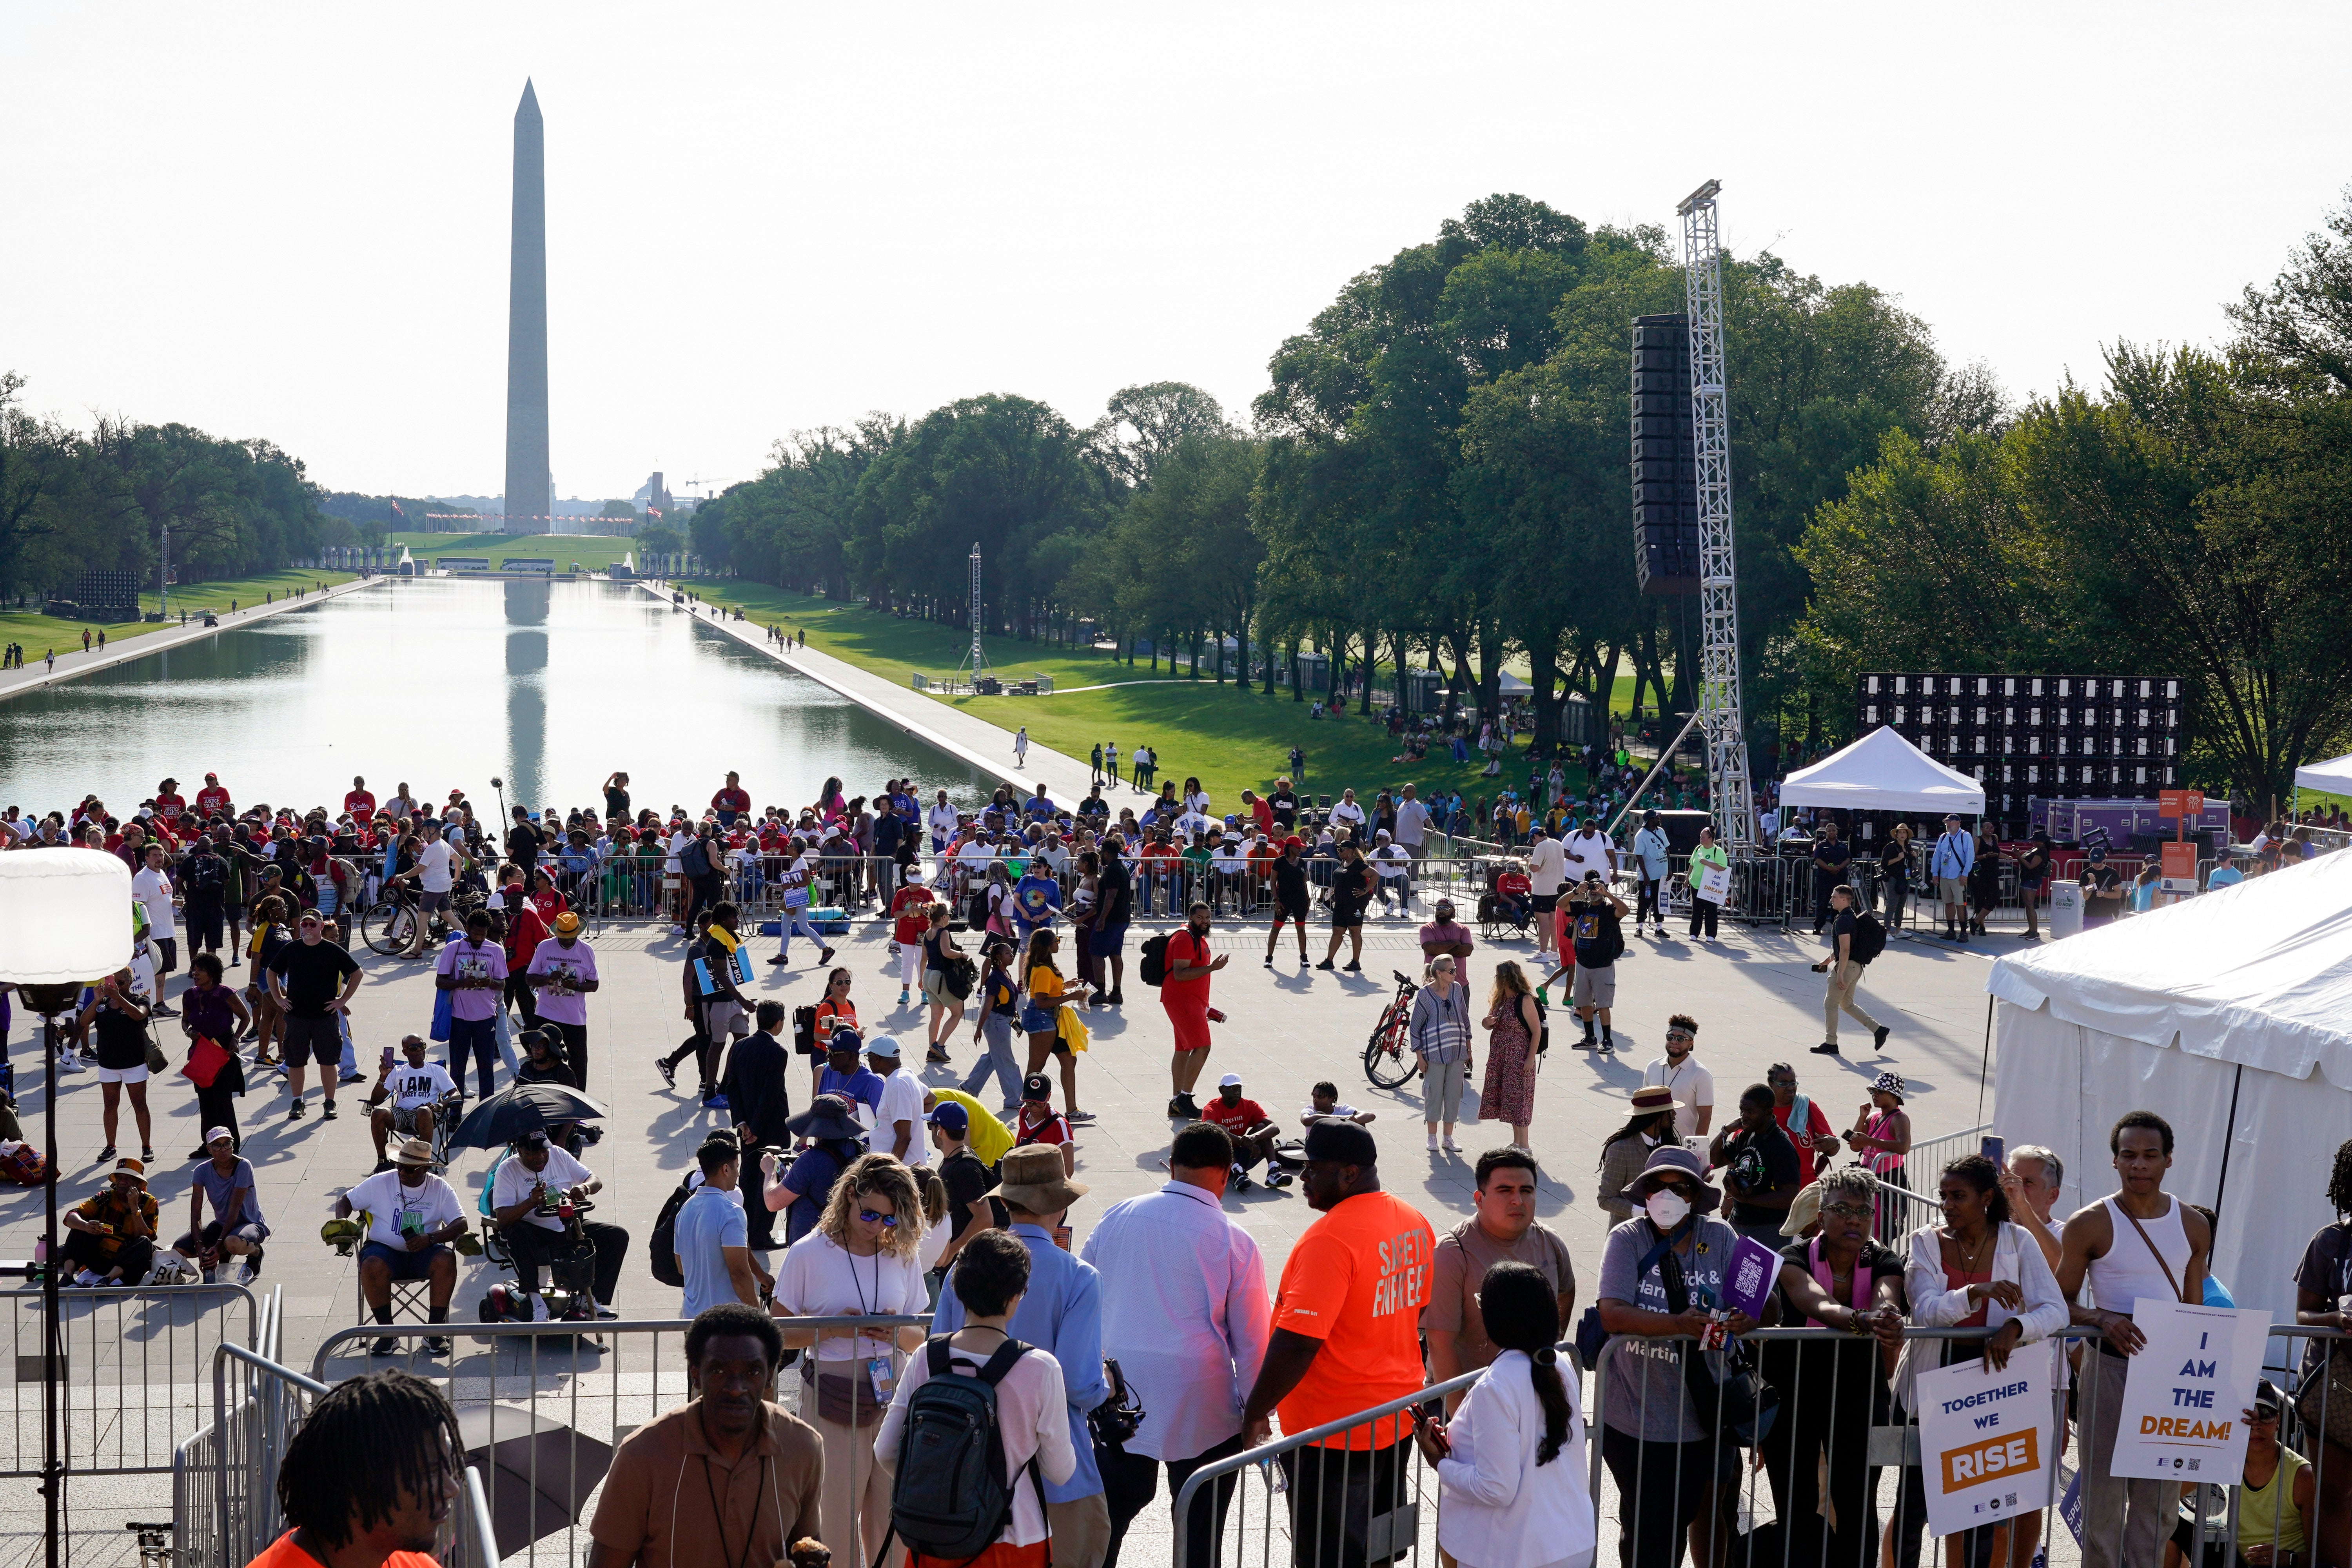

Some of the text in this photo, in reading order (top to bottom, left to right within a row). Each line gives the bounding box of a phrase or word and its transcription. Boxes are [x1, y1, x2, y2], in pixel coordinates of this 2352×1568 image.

[1704, 885, 1724, 895] DREAM!
[706, 969, 715, 981] WE
[728, 953, 744, 984] FOR ALL
[130, 982, 143, 992] THE
[399, 1076, 431, 1093] I AM
[1378, 1227, 1427, 1277] SAFETY
[1709, 1270, 1720, 1284] &
[1690, 1292, 1698, 1306] &
[2200, 1332, 2208, 1350] I
[1626, 1340, 1679, 1364] Martin
[2179, 1359, 2216, 1378] AM
[1942, 1381, 2029, 1414] TOGETHER
[2172, 1388, 2215, 1408] THE
[1973, 1413, 2000, 1430] WE
[2140, 1415, 2232, 1441] DREAM!
[1951, 1438, 2028, 1483] RISE
